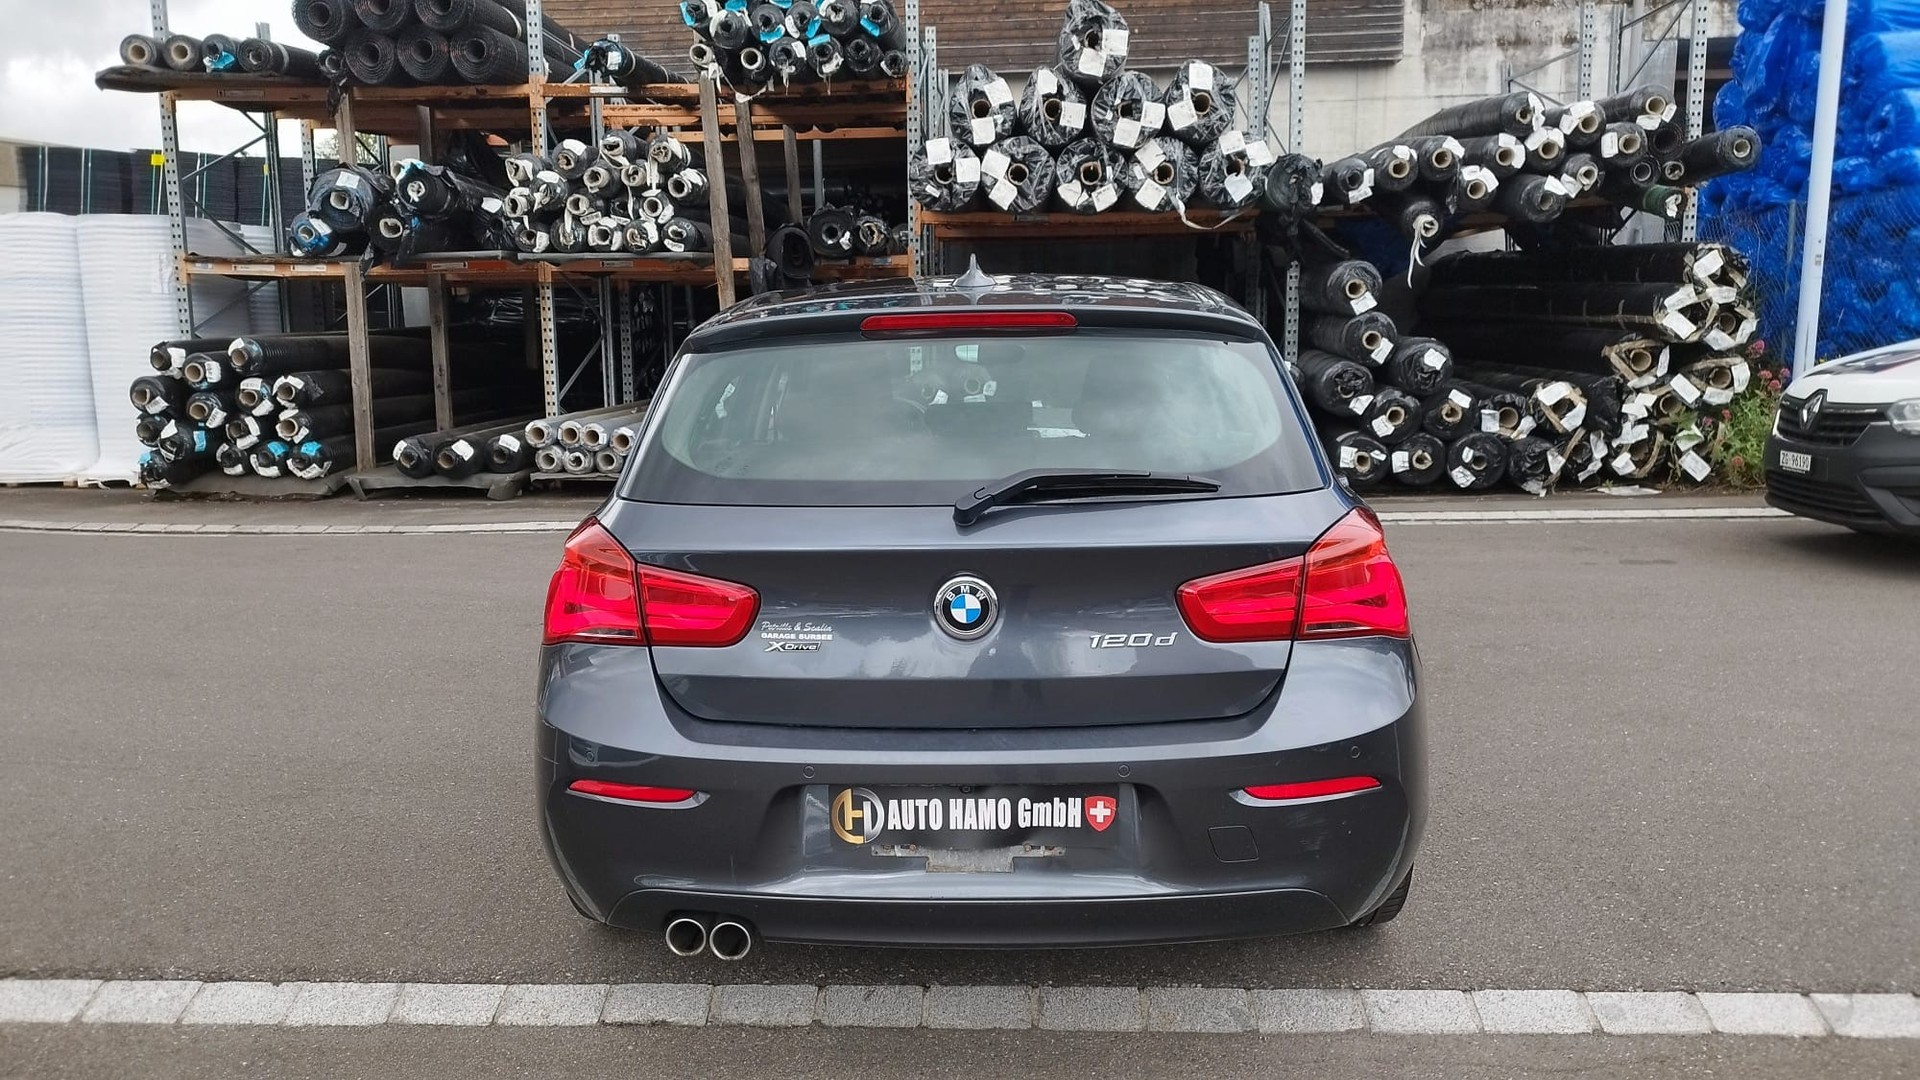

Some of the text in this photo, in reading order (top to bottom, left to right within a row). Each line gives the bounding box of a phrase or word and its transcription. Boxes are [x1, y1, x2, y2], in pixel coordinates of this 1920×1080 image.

[946, 585, 986, 601] BMW
[794, 622, 801, 631] &
[761, 632, 833, 641] GARAGE SURSEE
[887, 798, 943, 831] AUTO
[949, 798, 1011, 831] HAMO
[1018, 797, 1081, 829] GmbH
